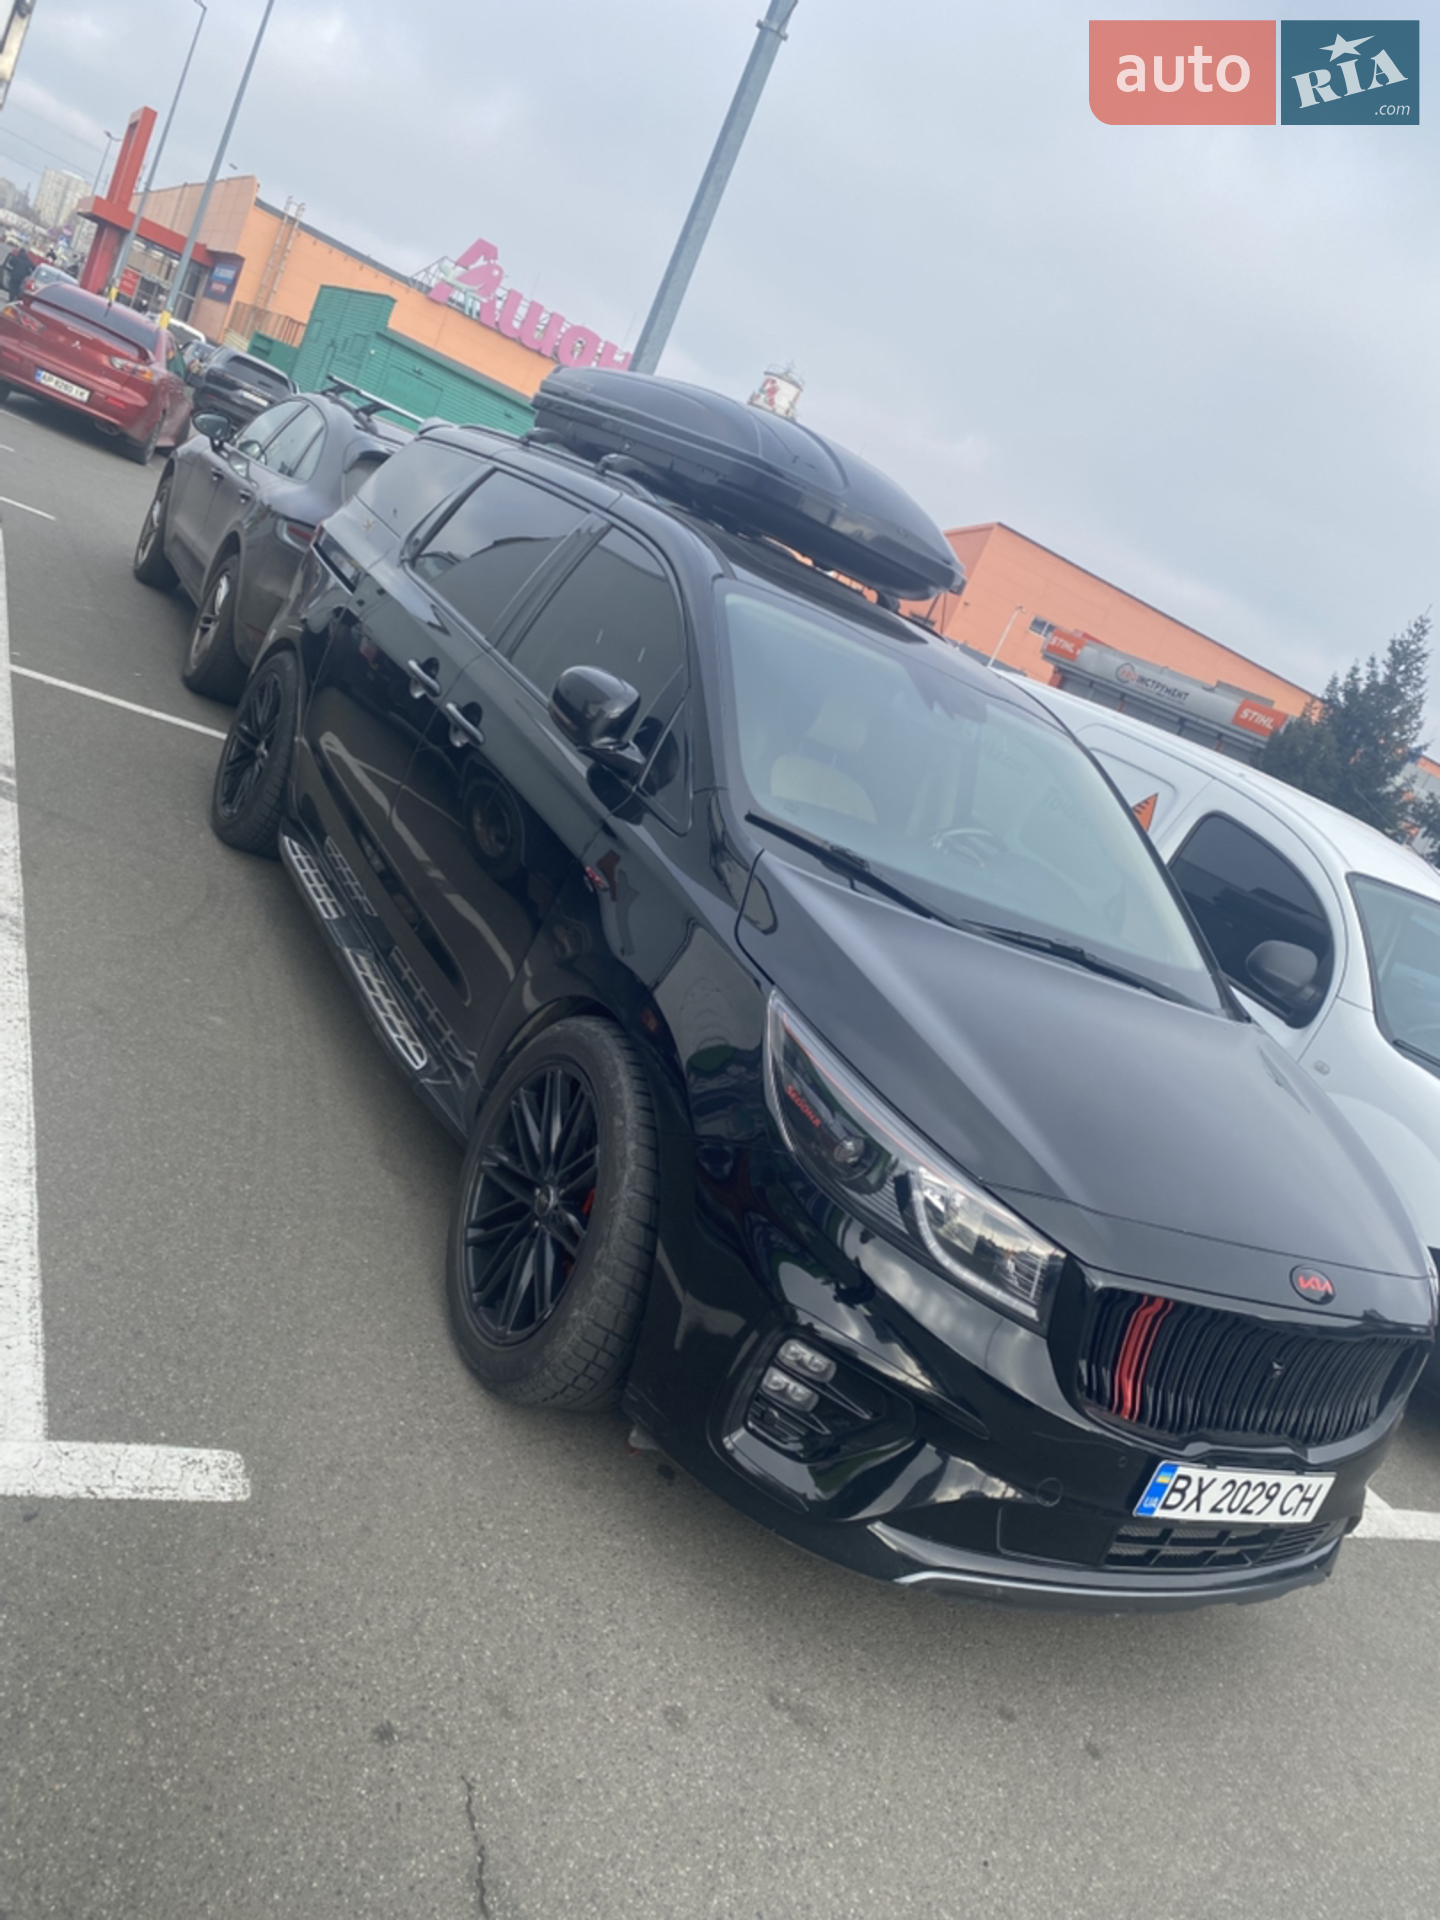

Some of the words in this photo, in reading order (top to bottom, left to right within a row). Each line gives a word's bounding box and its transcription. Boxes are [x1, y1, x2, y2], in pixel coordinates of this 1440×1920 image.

[1239, 707, 1275, 730] STIHL
[1297, 1275, 1334, 1295] KIA
[1142, 1496, 1159, 1509] UA
[1160, 1473, 1217, 1513] BX
[1208, 1478, 1281, 1516] 2029
[1279, 1482, 1324, 1517] CH
